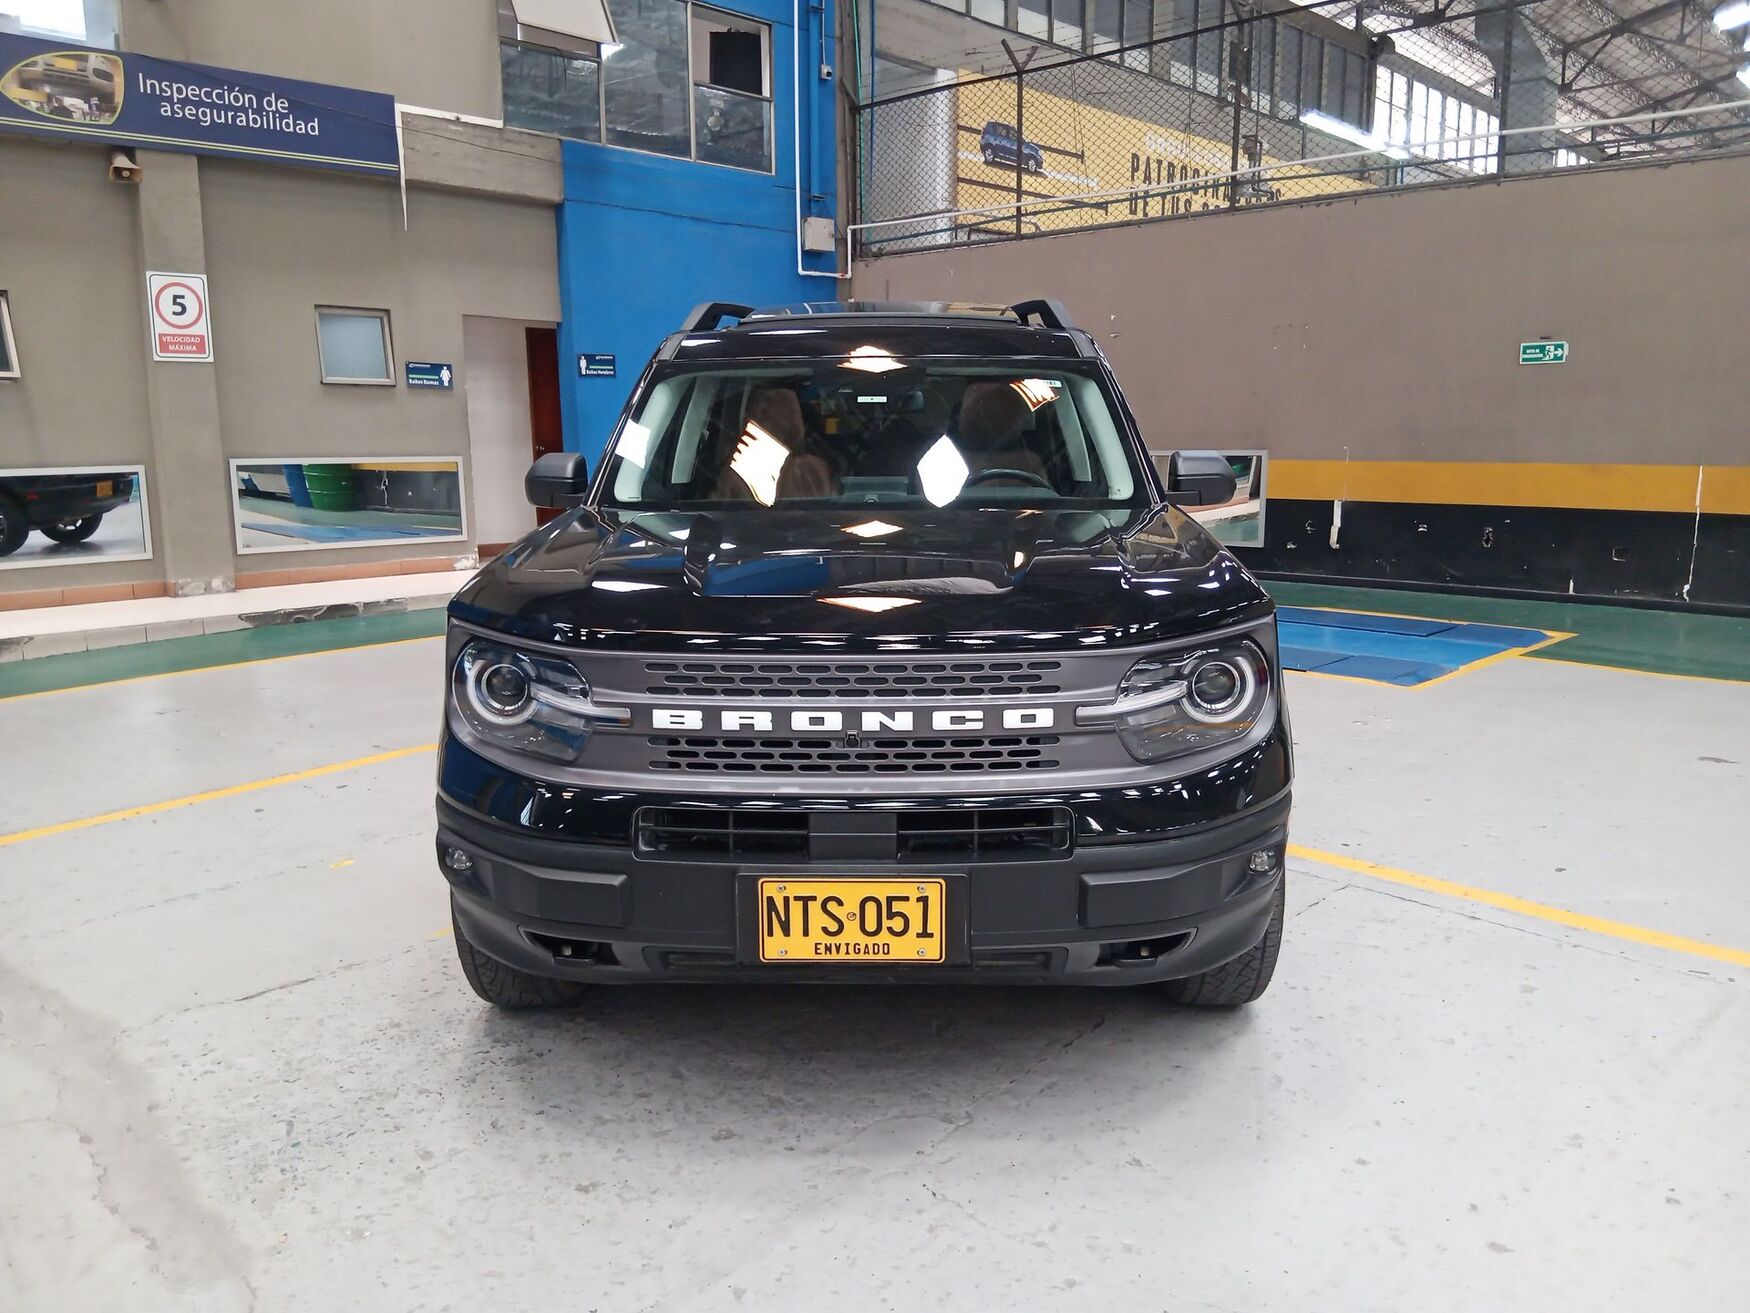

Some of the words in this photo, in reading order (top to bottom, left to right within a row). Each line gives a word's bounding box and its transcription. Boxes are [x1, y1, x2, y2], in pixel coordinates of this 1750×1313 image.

[138, 72, 257, 109] Inspección
[263, 92, 289, 113] de
[160, 101, 320, 136] asegurabilidad
[172, 294, 187, 316] 5
[652, 708, 1055, 731] BRONCO
[766, 895, 845, 938] NTS
[858, 895, 935, 939] 051
[814, 942, 891, 956] ENVIGADO
